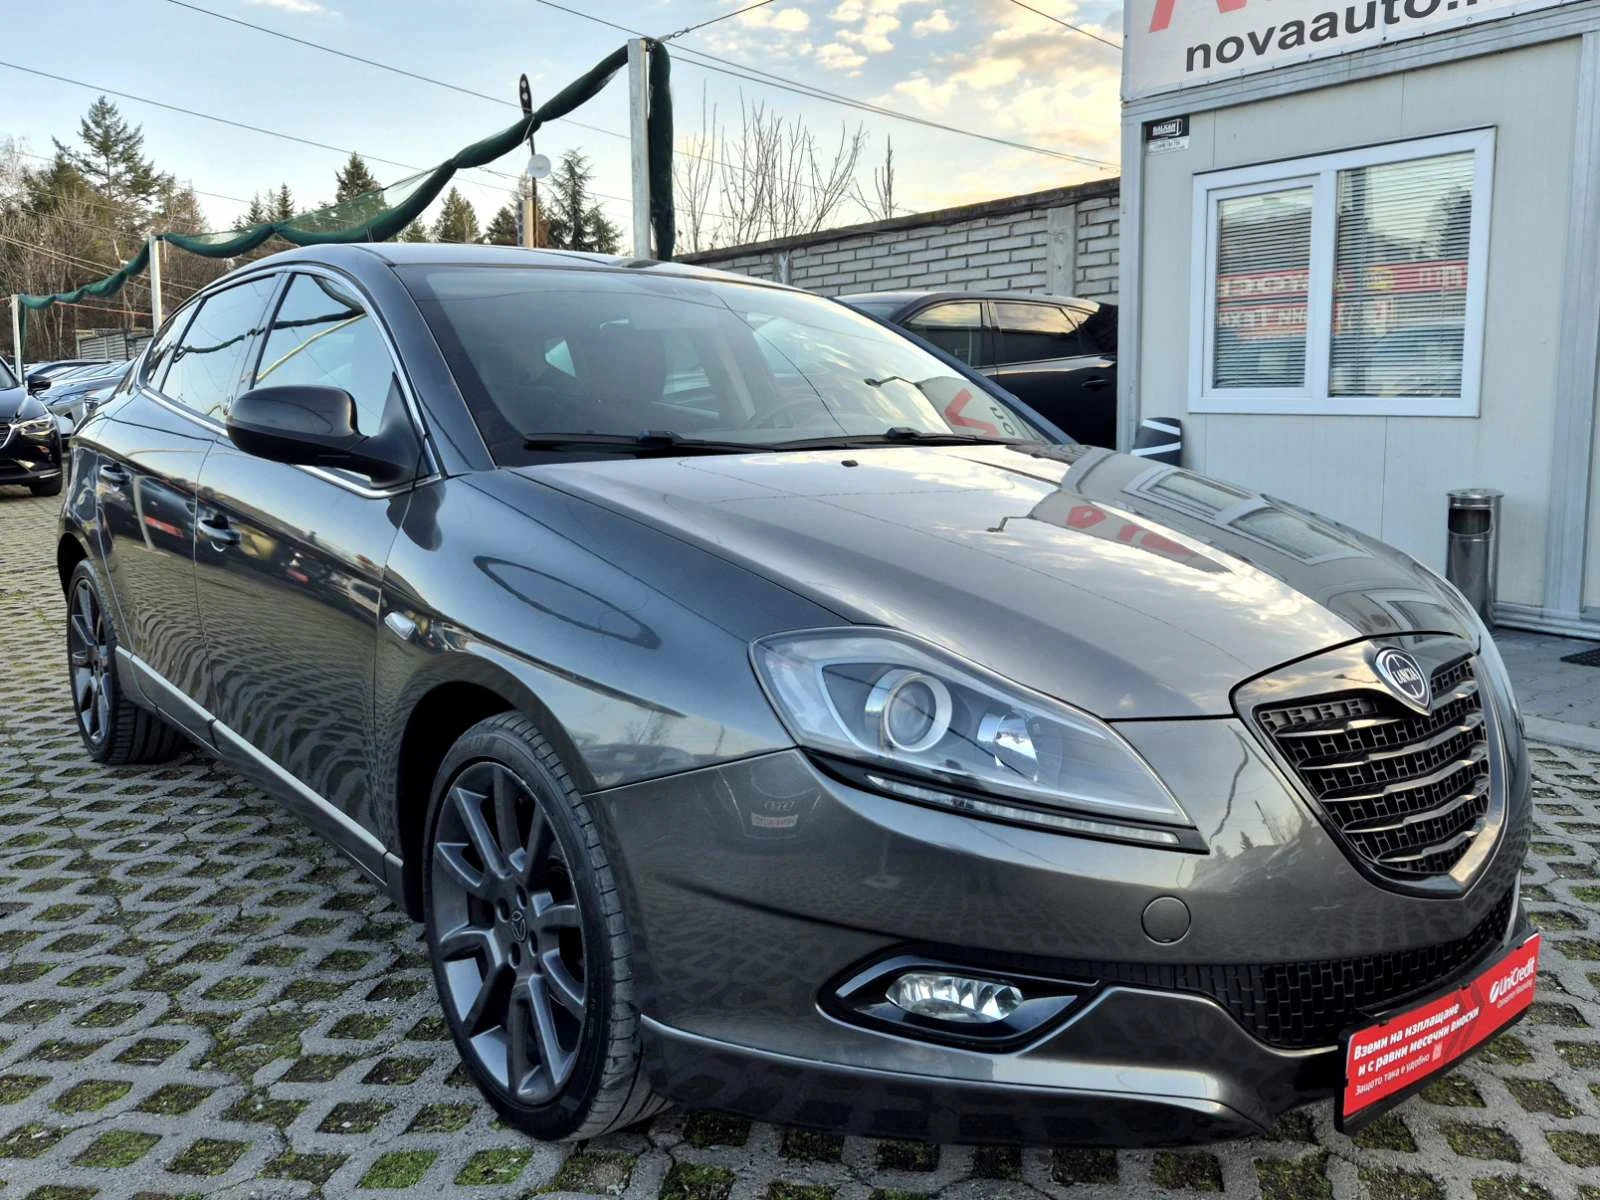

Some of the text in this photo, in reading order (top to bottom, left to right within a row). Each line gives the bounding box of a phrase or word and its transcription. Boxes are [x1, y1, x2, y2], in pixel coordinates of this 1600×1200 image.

[1186, 0, 1478, 72] novaauto.
[1392, 667, 1419, 684] LANCIA
[1499, 956, 1535, 996] UniCredit
[1354, 1003, 1460, 1060] Вземи на изплащане
[1358, 1006, 1480, 1077] и с равни месечни вноски
[1355, 1053, 1430, 1096] Защото така е удобно
